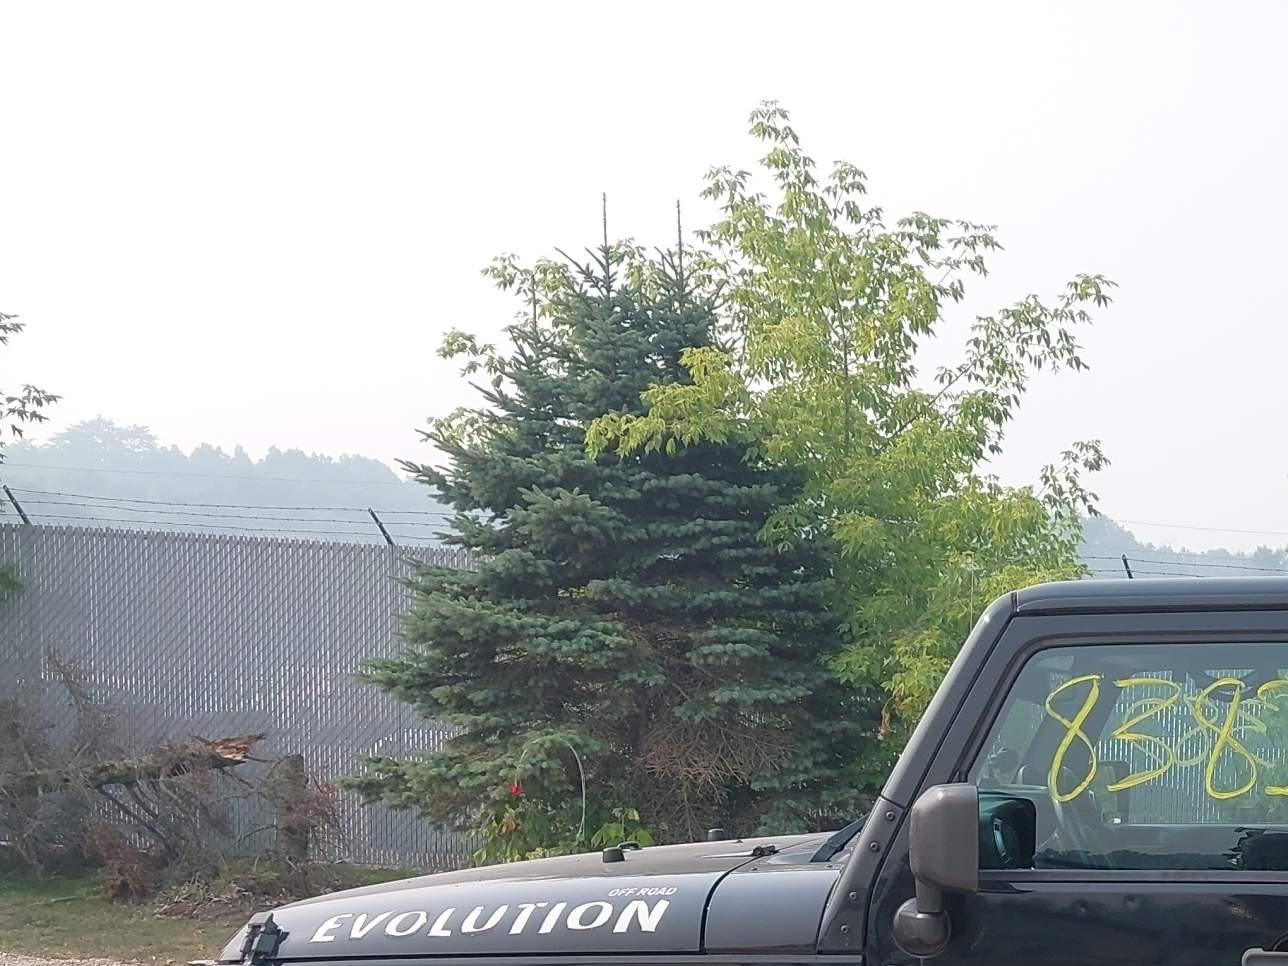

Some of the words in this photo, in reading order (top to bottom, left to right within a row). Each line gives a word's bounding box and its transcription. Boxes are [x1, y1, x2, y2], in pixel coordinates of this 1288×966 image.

[608, 887, 639, 897] OFF
[636, 886, 678, 897] ROAD
[309, 899, 671, 943] EVOLUTION
